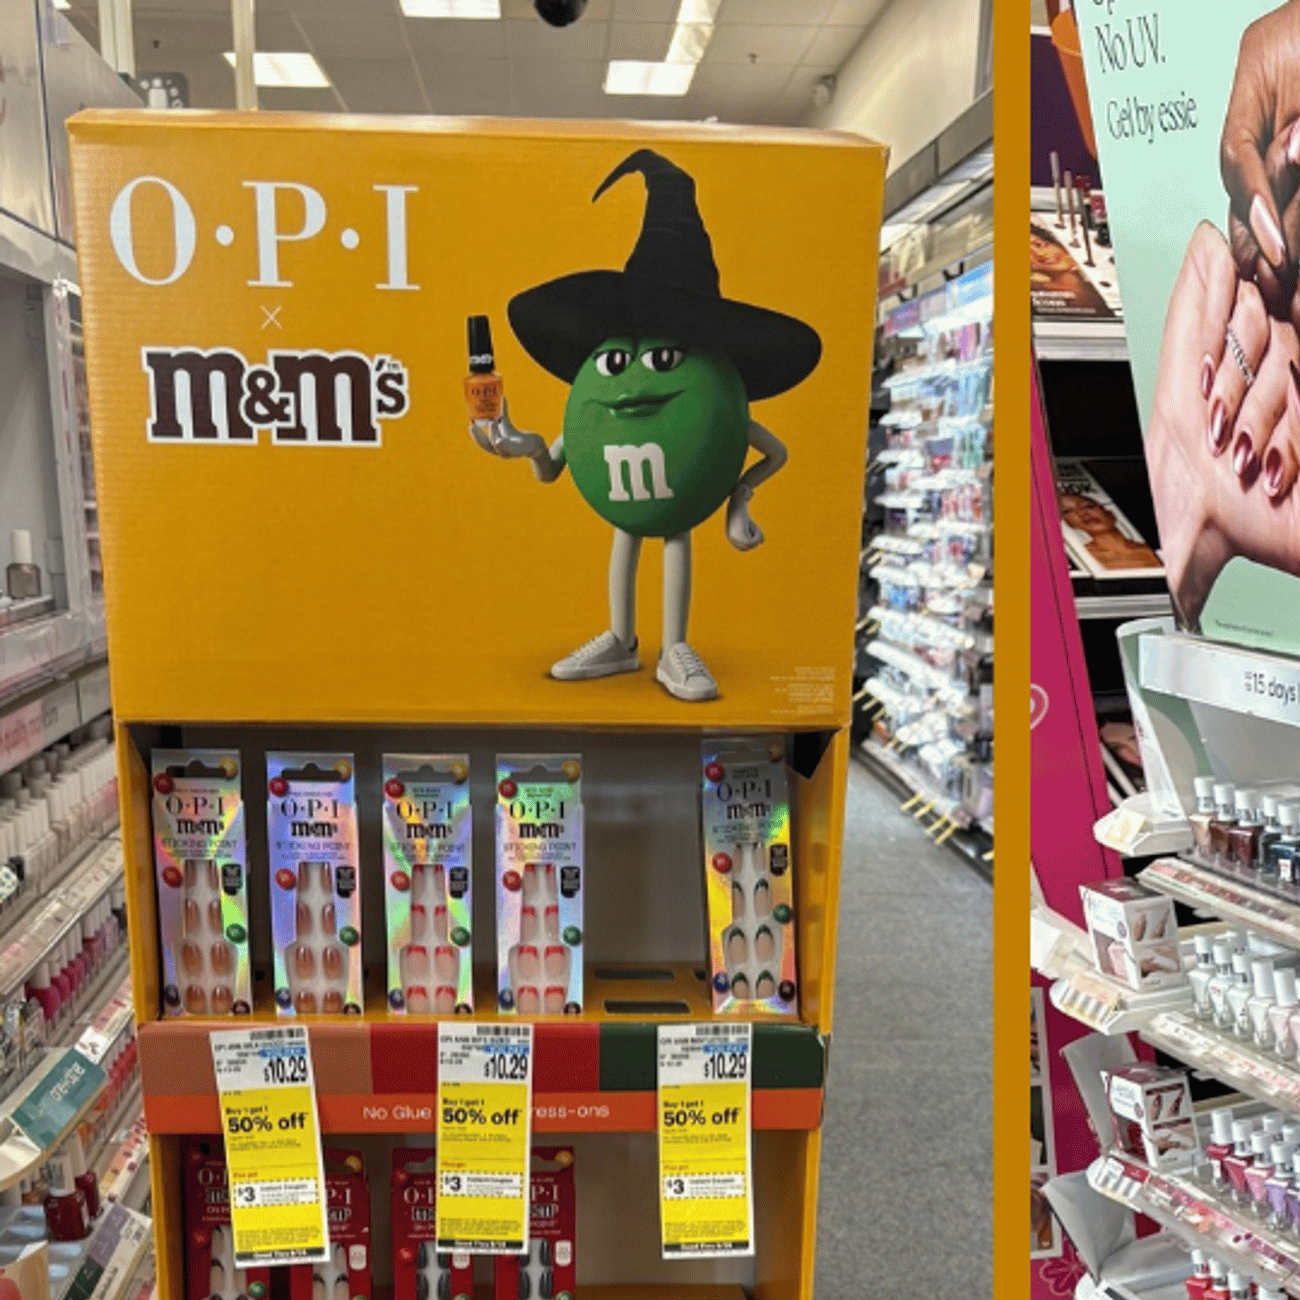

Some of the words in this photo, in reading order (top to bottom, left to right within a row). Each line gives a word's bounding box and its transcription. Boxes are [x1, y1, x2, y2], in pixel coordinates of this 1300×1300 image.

[1158, 91, 1199, 132] essie
[603, 442, 674, 501] m
[264, 1056, 307, 1082] $10.29
[485, 1054, 528, 1079] $10.29
[704, 1053, 747, 1079] $10.29
[228, 1116, 272, 1133] 50%
[363, 1106, 387, 1120] No
[393, 1105, 432, 1120] Glue
[530, 1105, 610, 1119] ress-ons
[442, 1108, 487, 1125] 50%
[664, 1109, 706, 1127] 50%
